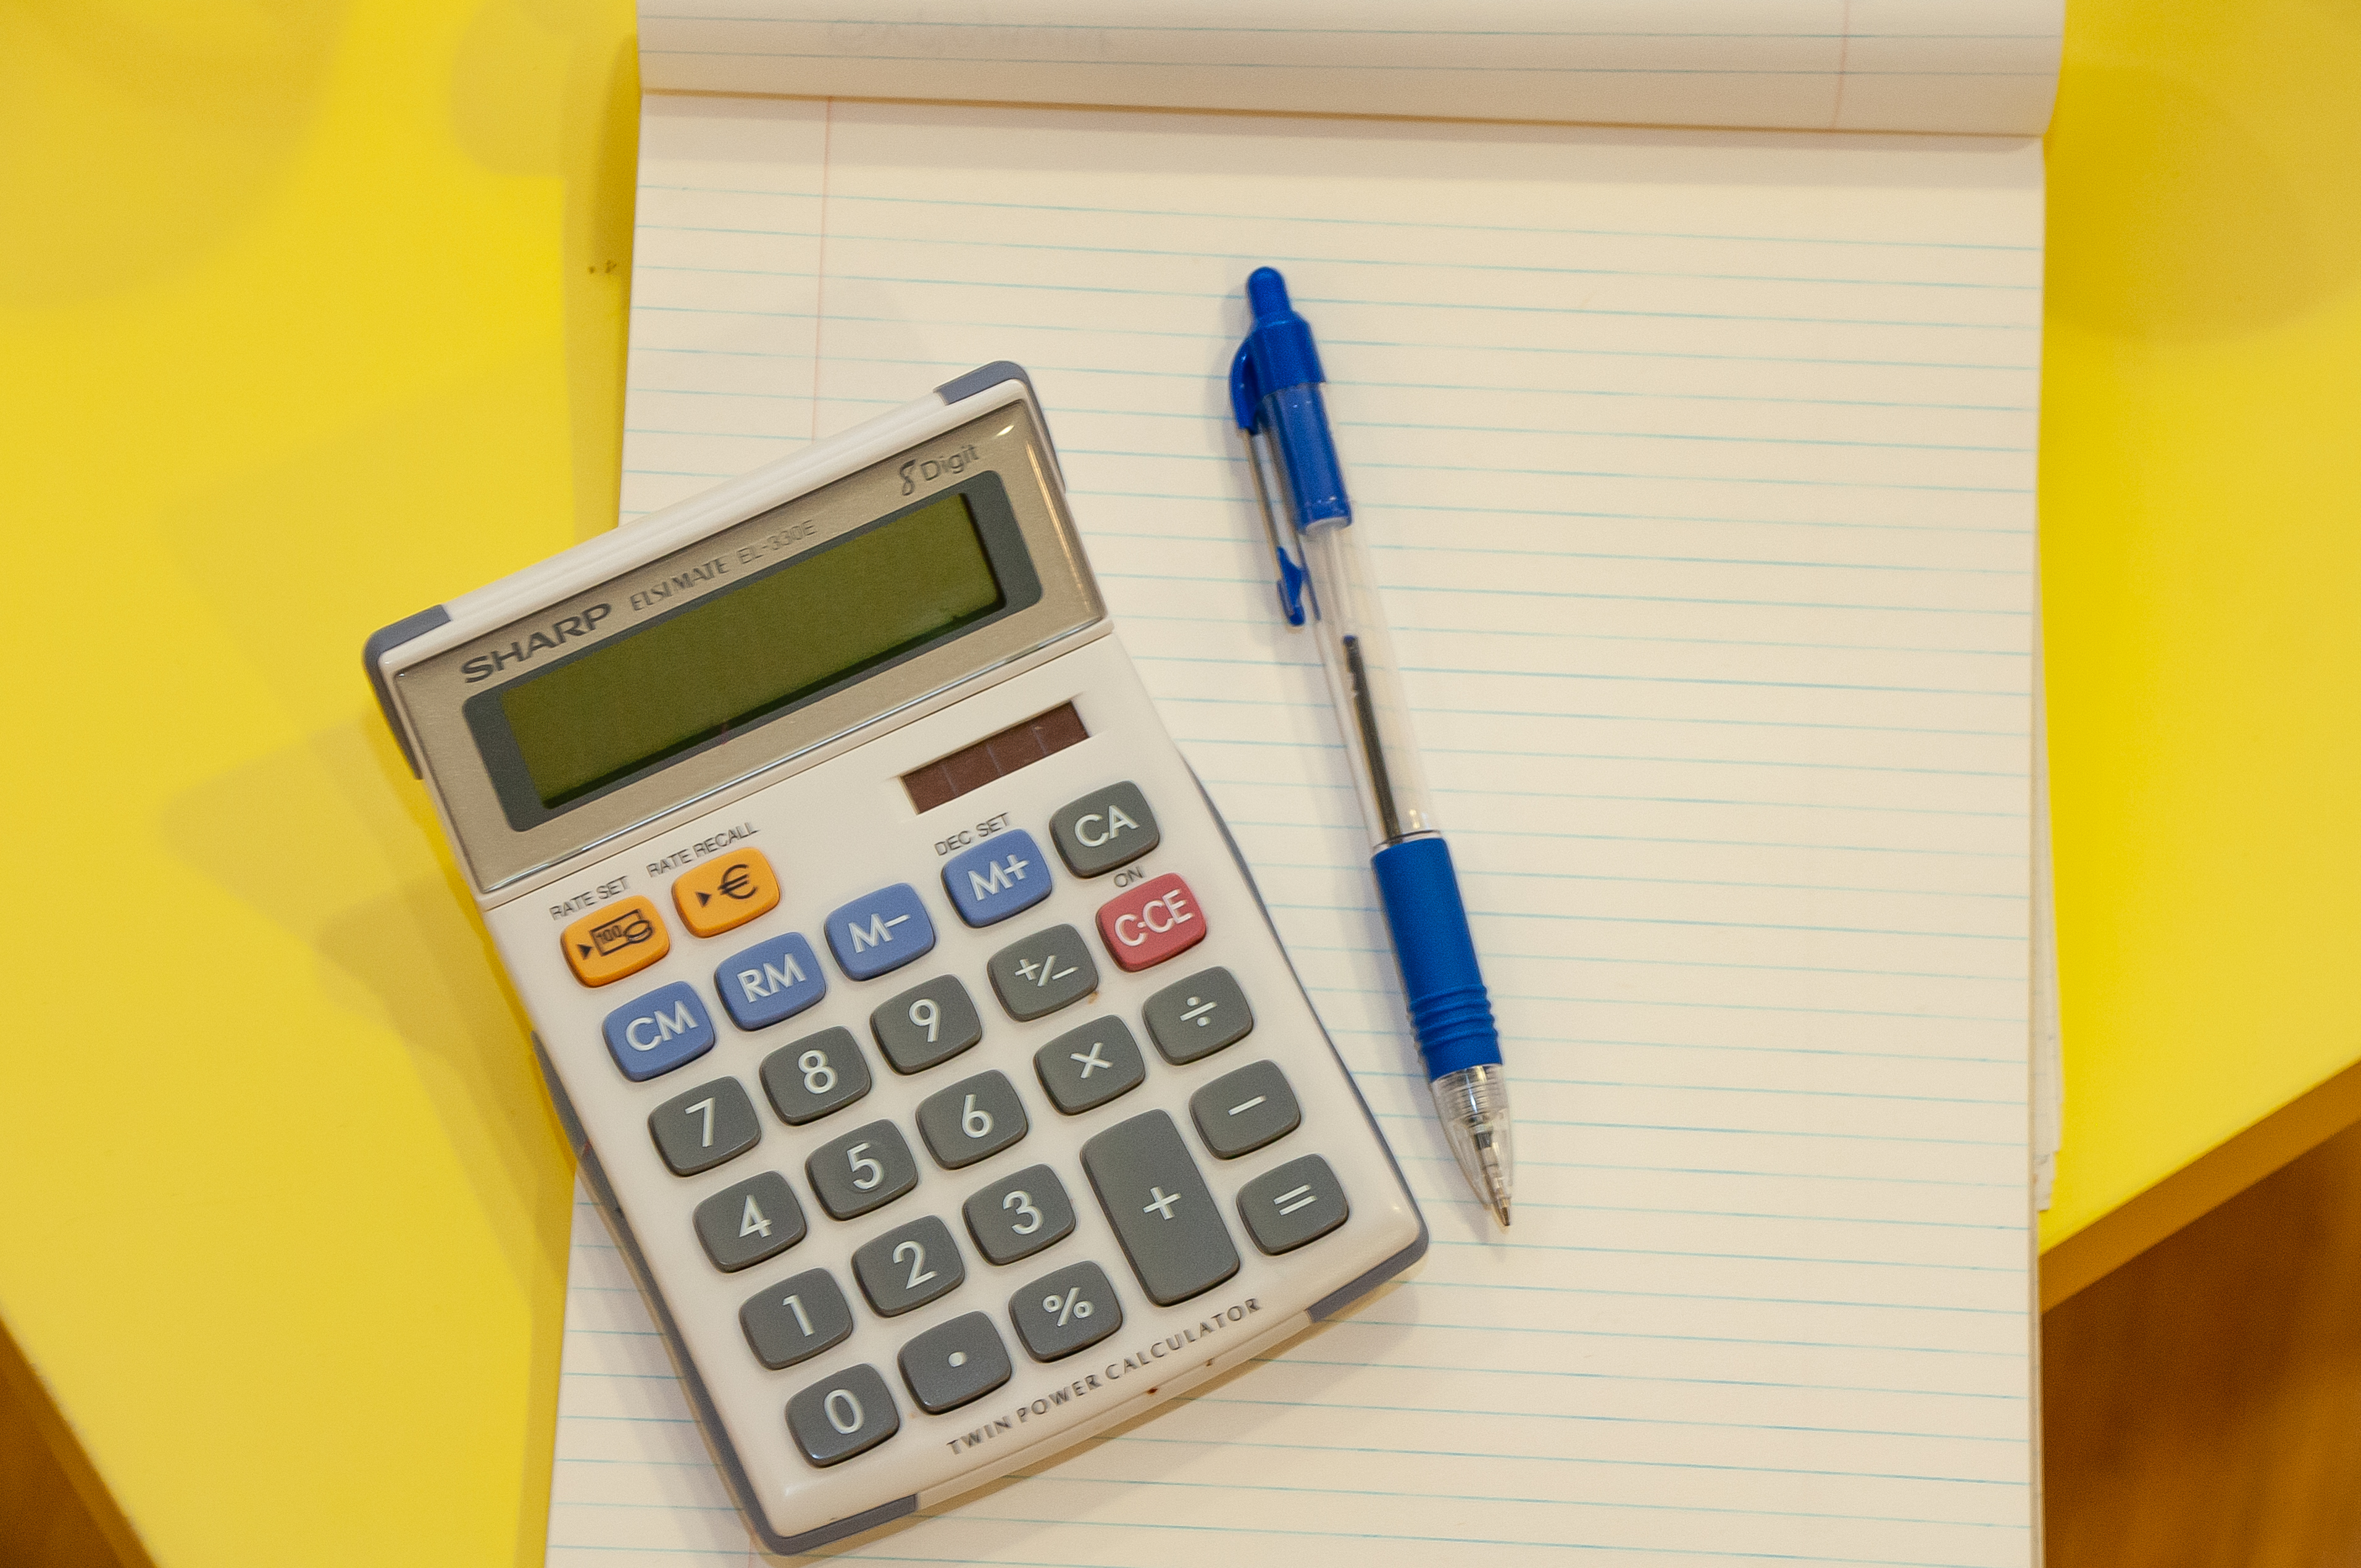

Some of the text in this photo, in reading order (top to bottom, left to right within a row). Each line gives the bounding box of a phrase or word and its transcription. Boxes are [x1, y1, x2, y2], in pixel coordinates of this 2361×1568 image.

[900, 444, 979, 496] 8 Digit
[460, 519, 817, 684] SHARP ELSIMATE EL-330E
[934, 812, 1009, 856] DEC SET
[1074, 805, 1139, 847] CA
[646, 822, 761, 878] RATE RECALL
[549, 875, 630, 920] RATE SET
[717, 864, 758, 900] €
[968, 854, 1030, 901] M+
[1114, 865, 1147, 888] ON
[595, 925, 622, 942] 100
[737, 953, 806, 1003] RM
[626, 1000, 698, 1051] CM
[909, 998, 941, 1042] 9
[798, 1049, 837, 1095] 8
[685, 1097, 716, 1148] 7
[961, 1094, 994, 1138] 6
[846, 1142, 884, 1190] 5
[739, 1195, 772, 1238] 4
[1003, 1190, 1043, 1235] 3
[893, 1241, 938, 1290] 2
[782, 1295, 815, 1338] 1
[1042, 1287, 1095, 1327] %
[946, 1298, 1262, 1455] TWIN POWER CALCULATOR
[824, 1388, 864, 1434] 0
